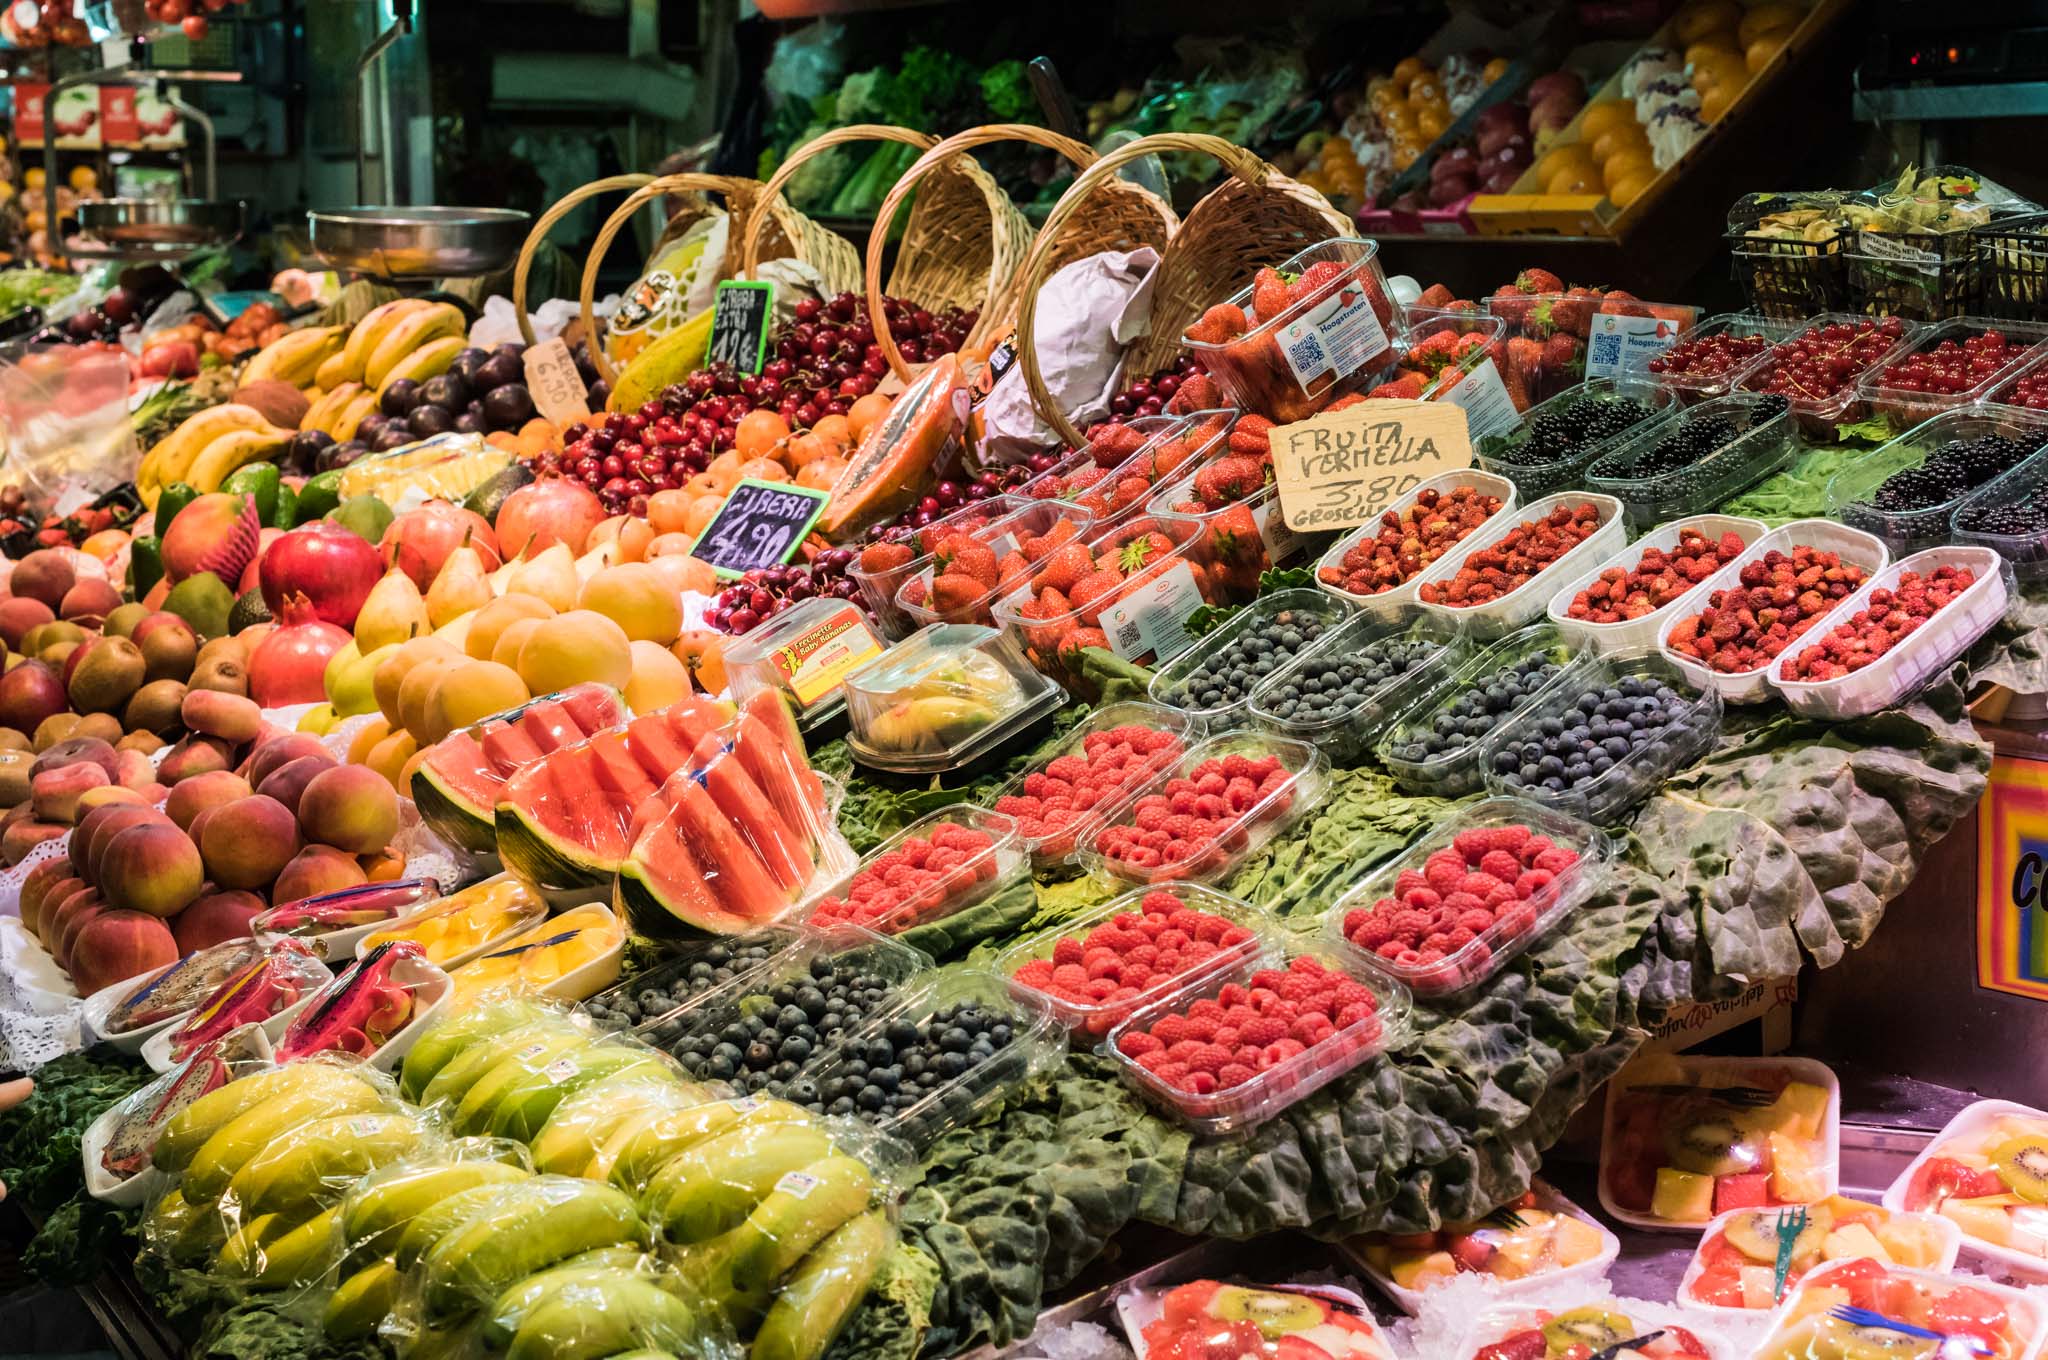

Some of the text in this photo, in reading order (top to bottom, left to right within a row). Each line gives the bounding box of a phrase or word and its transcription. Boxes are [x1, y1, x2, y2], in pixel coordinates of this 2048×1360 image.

[1319, 298, 1367, 335] Hoogstraten
[1301, 436, 1441, 479] VERMELLA
[1310, 473, 1422, 508] 3,80
[793, 623, 833, 650] Frecinette
[799, 641, 820, 656] Baby
[820, 620, 853, 643] Bananas
